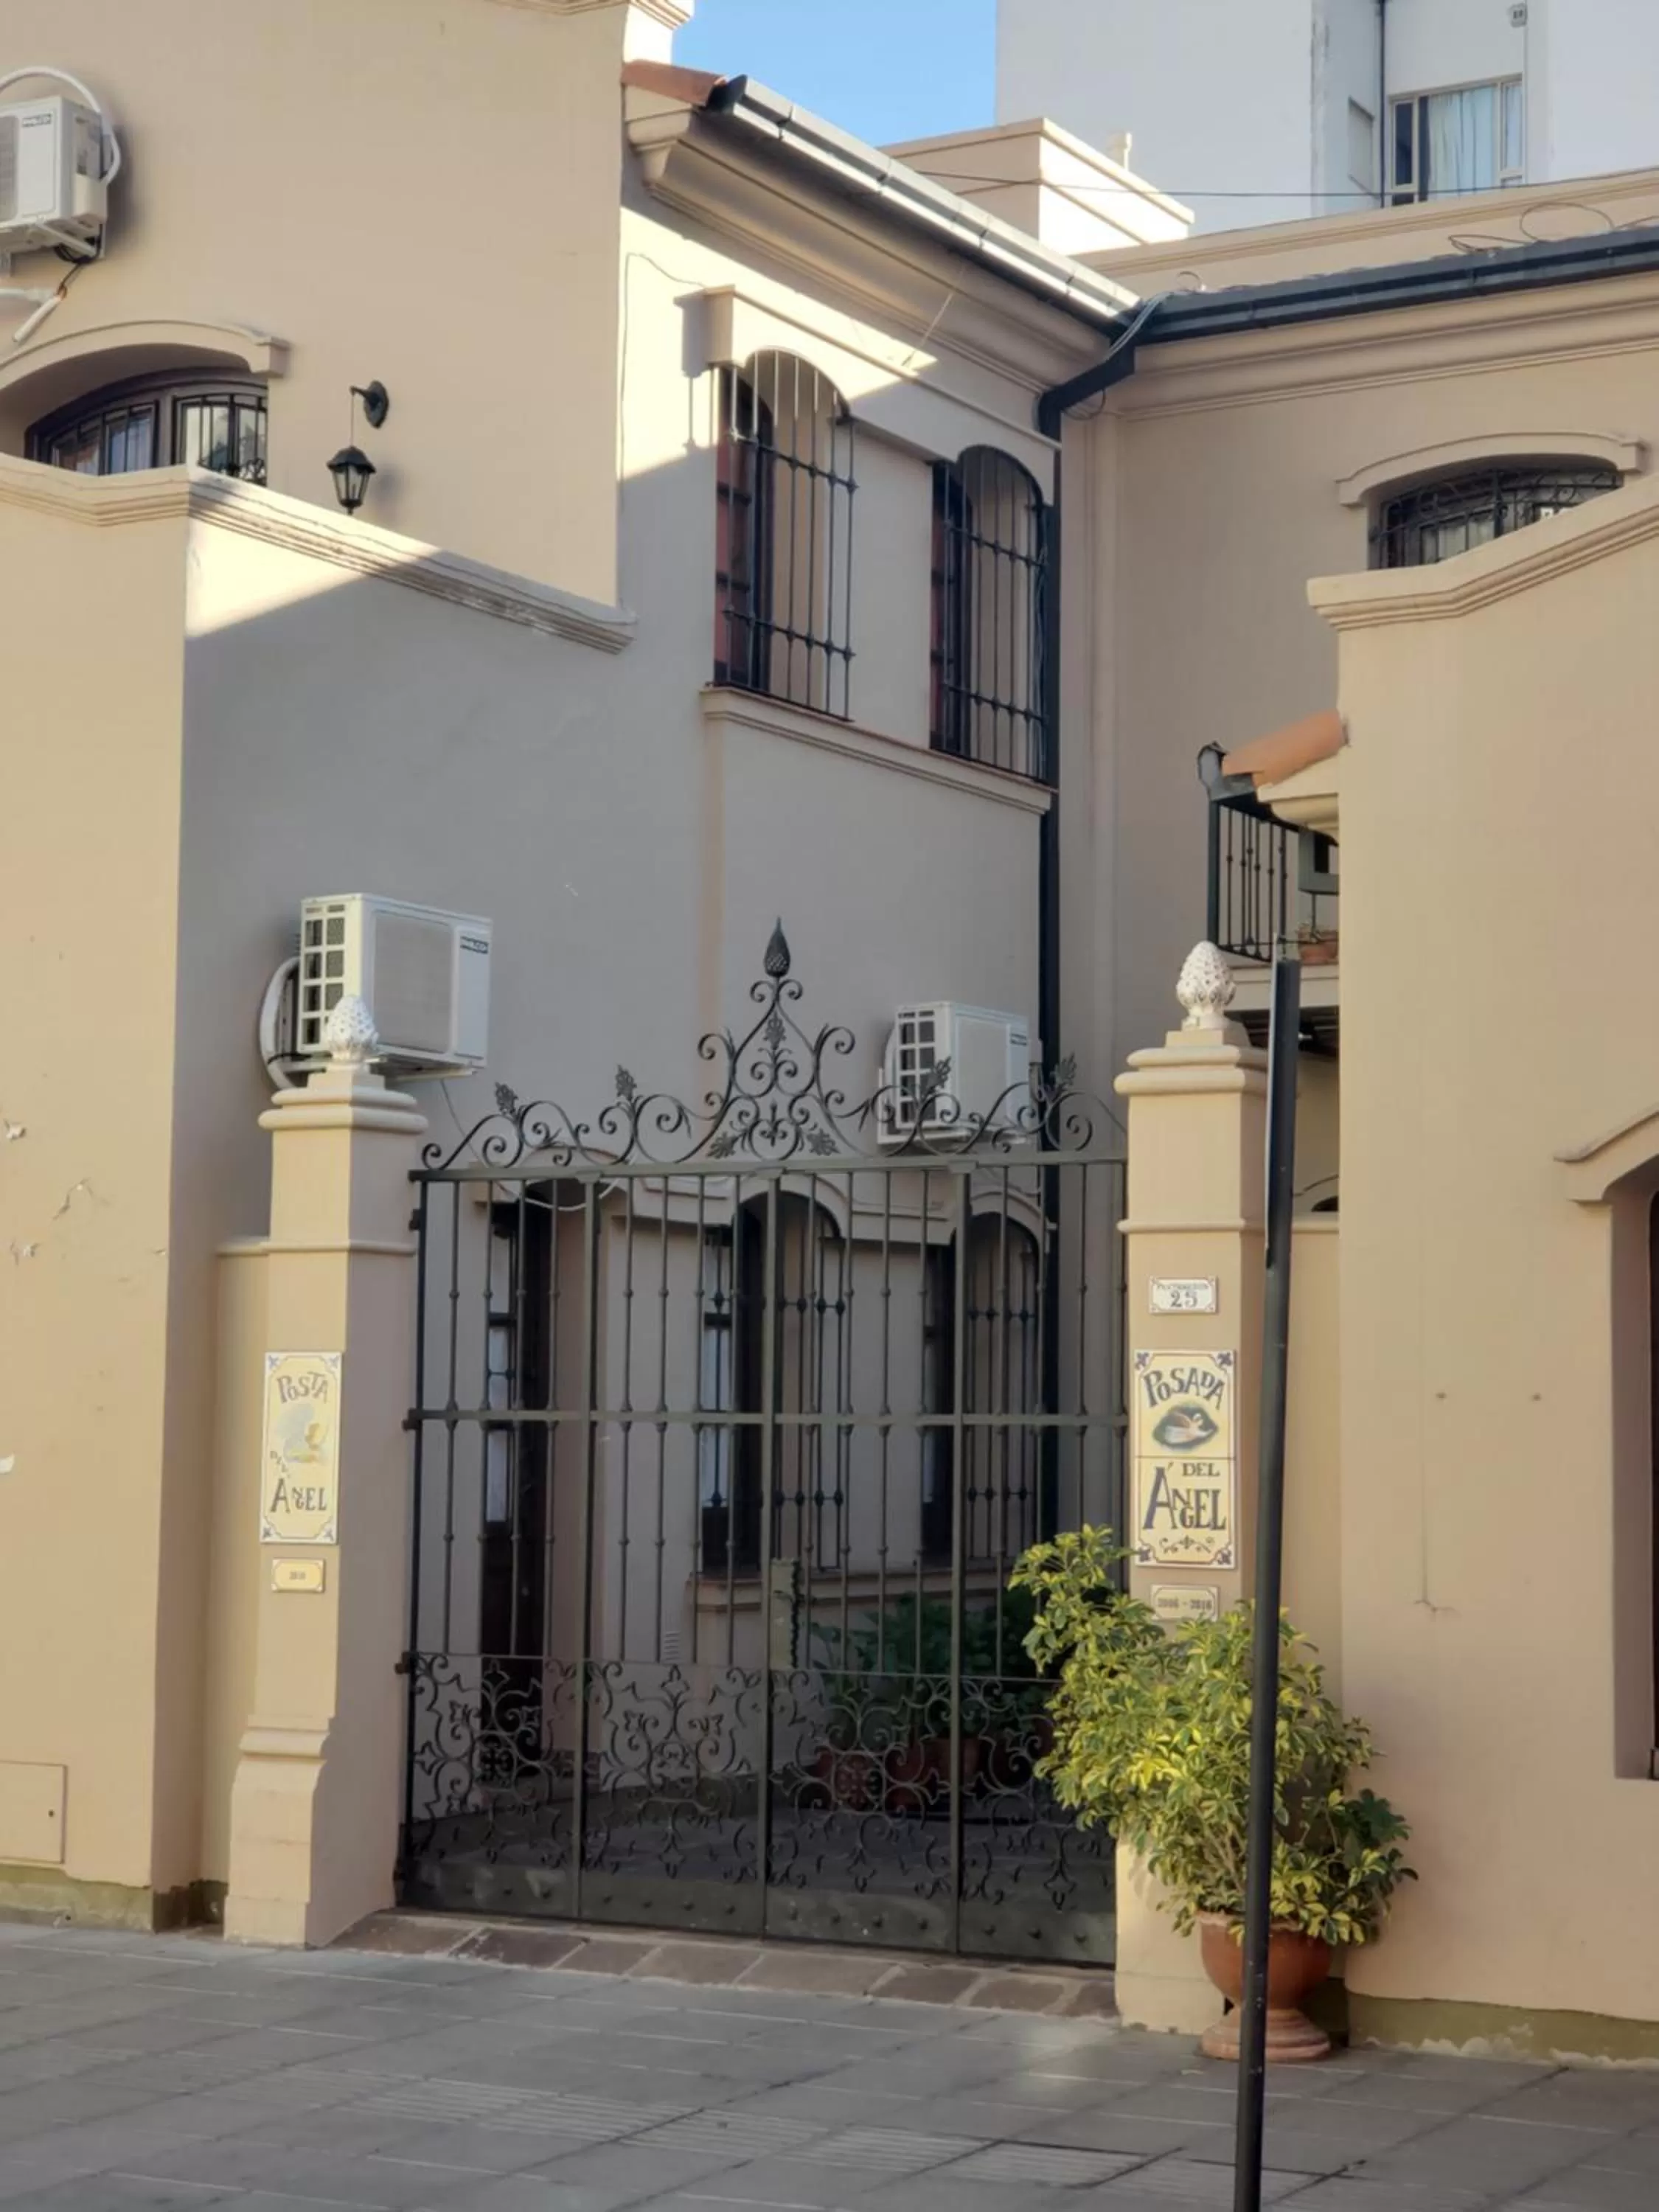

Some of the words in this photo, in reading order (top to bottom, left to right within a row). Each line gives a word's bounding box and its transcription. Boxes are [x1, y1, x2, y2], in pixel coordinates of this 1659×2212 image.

[1170, 1290, 1198, 1308] 25
[1143, 1366, 1225, 1410] POSADA
[1182, 1461, 1221, 1478] DEL
